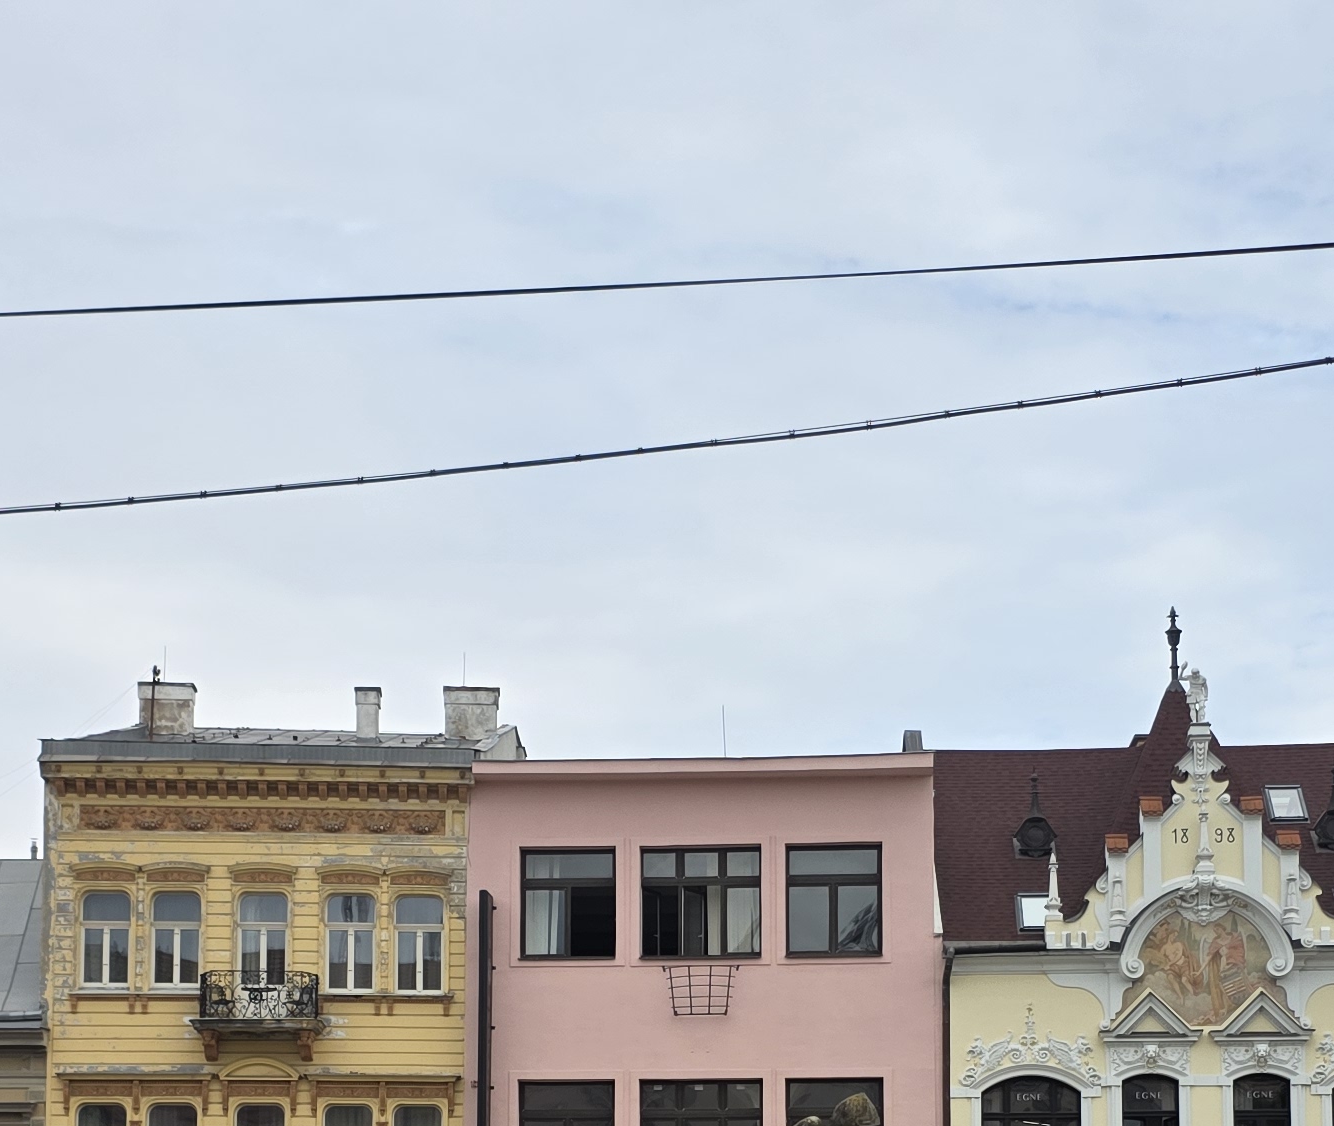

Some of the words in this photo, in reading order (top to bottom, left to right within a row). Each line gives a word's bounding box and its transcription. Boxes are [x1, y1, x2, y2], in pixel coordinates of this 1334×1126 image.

[1016, 1093, 1042, 1101] EGNE
[1135, 1091, 1162, 1099] EGNE
[1246, 1090, 1274, 1099] EGNE
